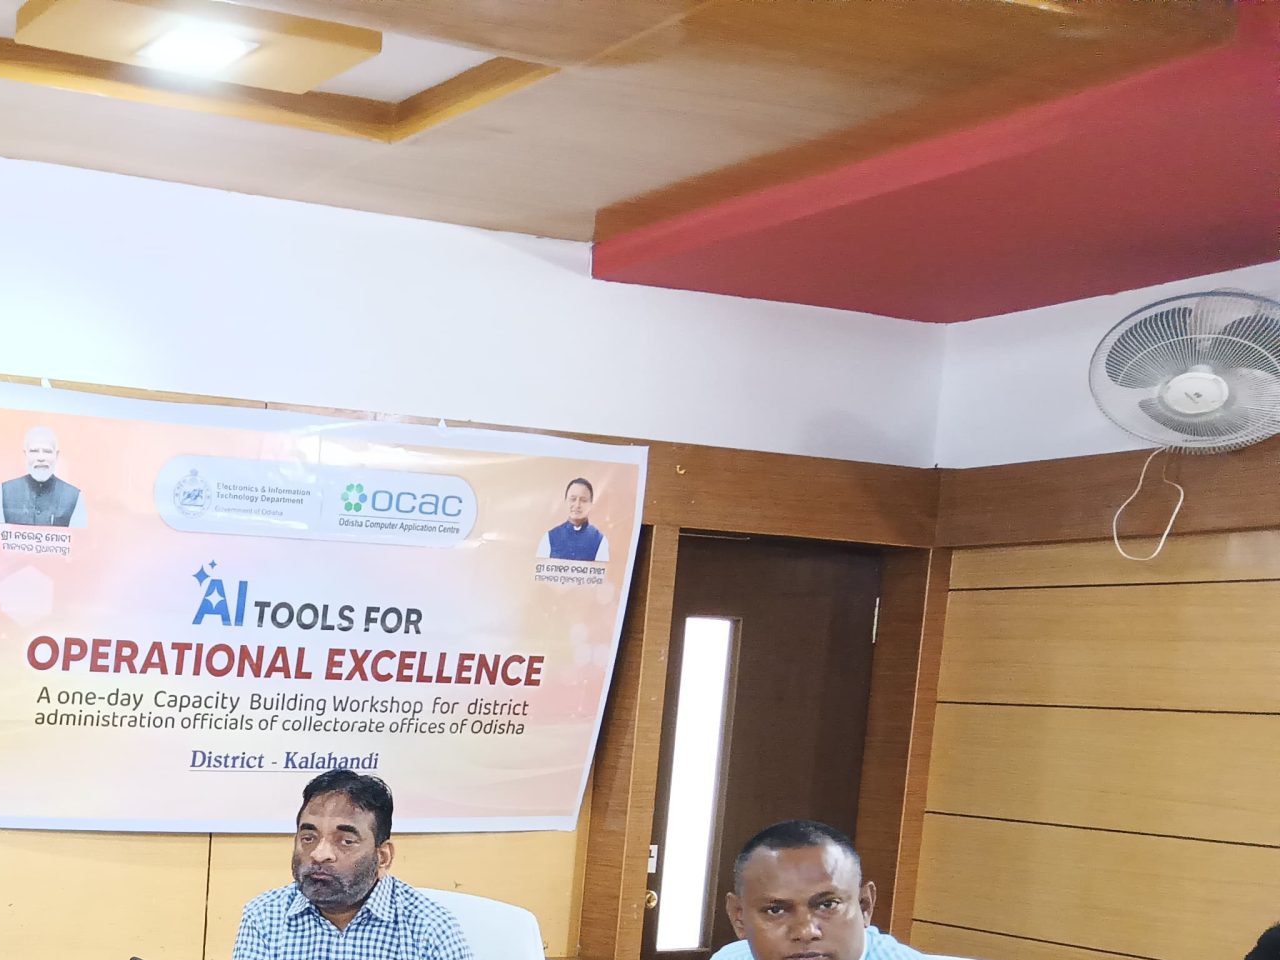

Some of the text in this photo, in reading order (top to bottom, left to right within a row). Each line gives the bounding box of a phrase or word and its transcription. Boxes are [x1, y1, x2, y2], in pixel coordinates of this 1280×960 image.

[216, 482, 259, 493] Electronics
[268, 487, 311, 496] Information
[216, 492, 304, 505] Technology Department
[371, 490, 463, 517] ocac
[338, 518, 460, 534] Odisha Computer Application Centre
[192, 578, 423, 635] AI TOOLS FOR
[27, 635, 545, 687] OPERATIONAL EXCELLENCE
[36, 686, 529, 718] A one-day Capacity Building Workshop for district
[34, 709, 525, 735] administration officials of collectorate offices of Odisha
[190, 750, 265, 769] District
[283, 751, 379, 770] Kalahandi
